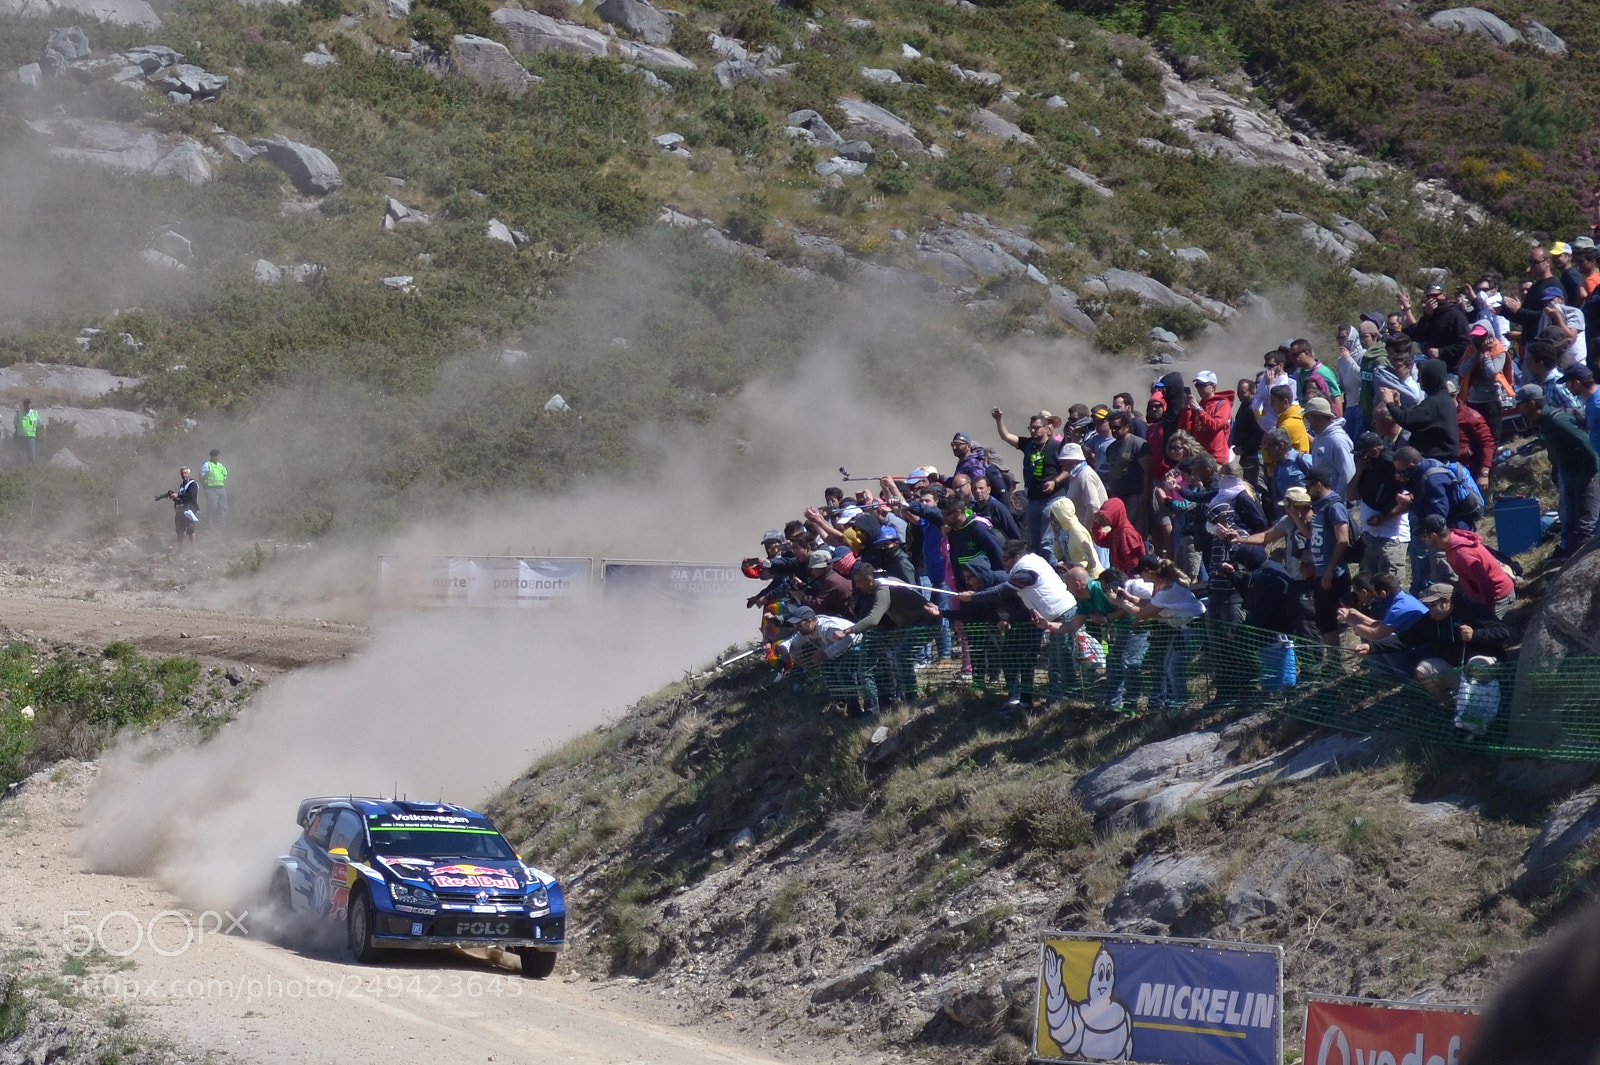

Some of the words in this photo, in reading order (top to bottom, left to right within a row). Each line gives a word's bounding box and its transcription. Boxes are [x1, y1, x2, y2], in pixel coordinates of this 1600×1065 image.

[391, 813, 470, 824] Volkswagen
[434, 876, 480, 888] Red
[477, 876, 520, 889] Bull
[412, 907, 438, 916] EDGE
[456, 922, 511, 936] POLO
[1134, 982, 1275, 1029] MICHELIN
